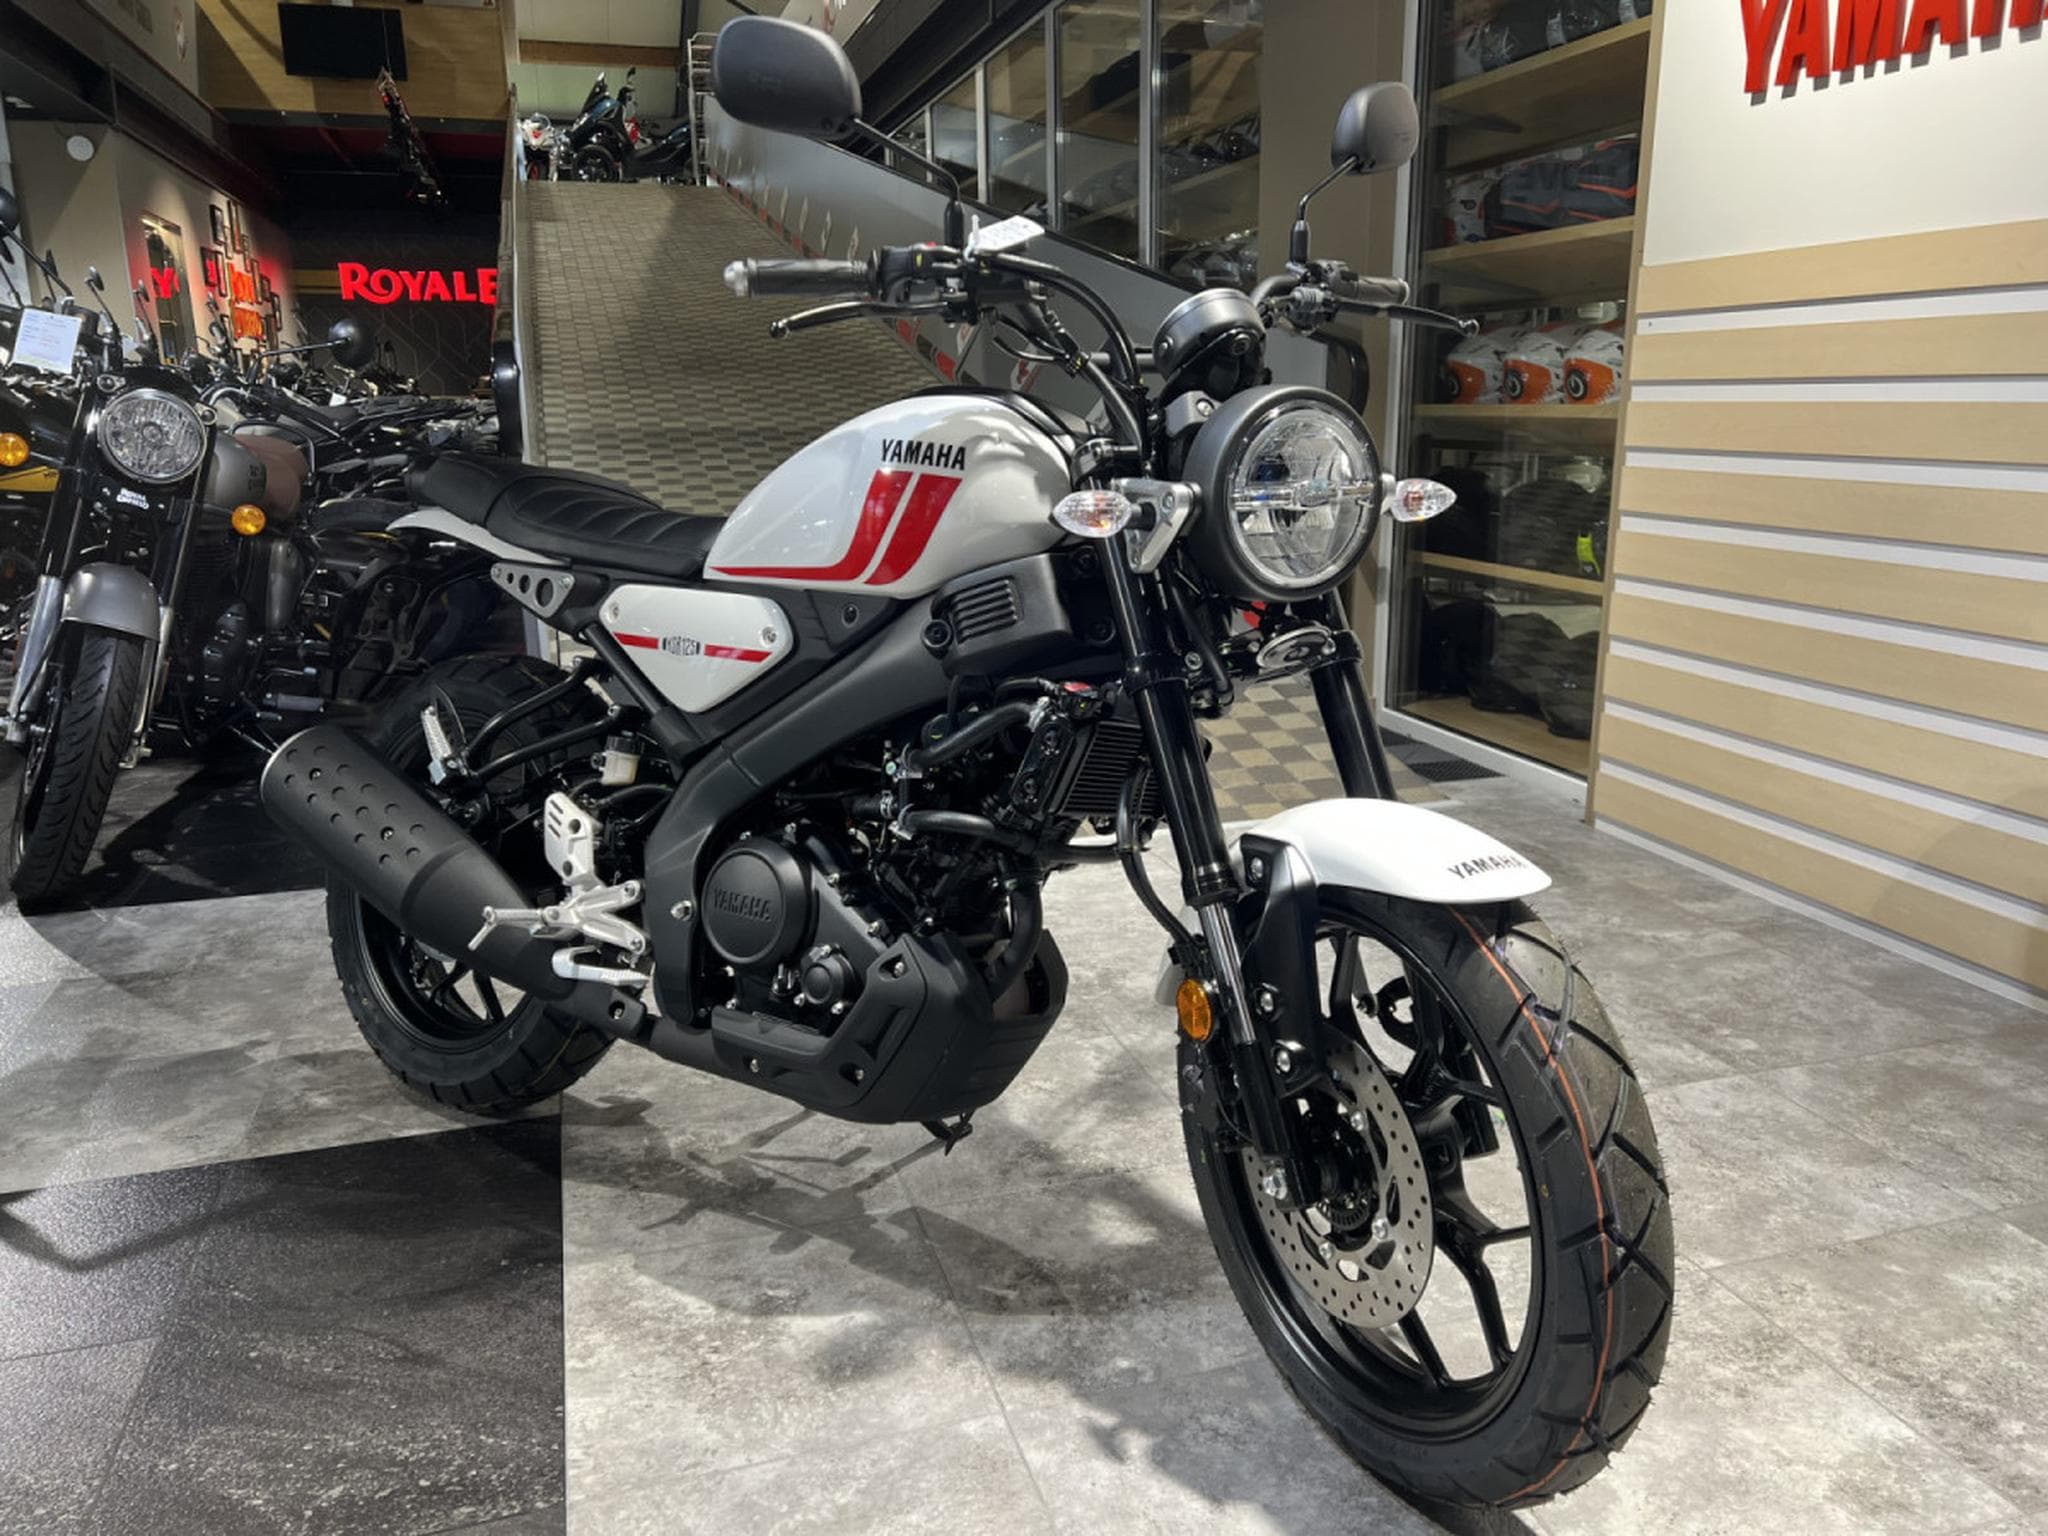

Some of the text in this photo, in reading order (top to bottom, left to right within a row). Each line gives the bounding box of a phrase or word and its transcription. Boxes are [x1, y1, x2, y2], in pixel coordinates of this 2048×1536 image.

[1741, 0, 2048, 93] YAM
[881, 438, 966, 471] YAMAHA
[714, 887, 770, 922] YAMAHA
